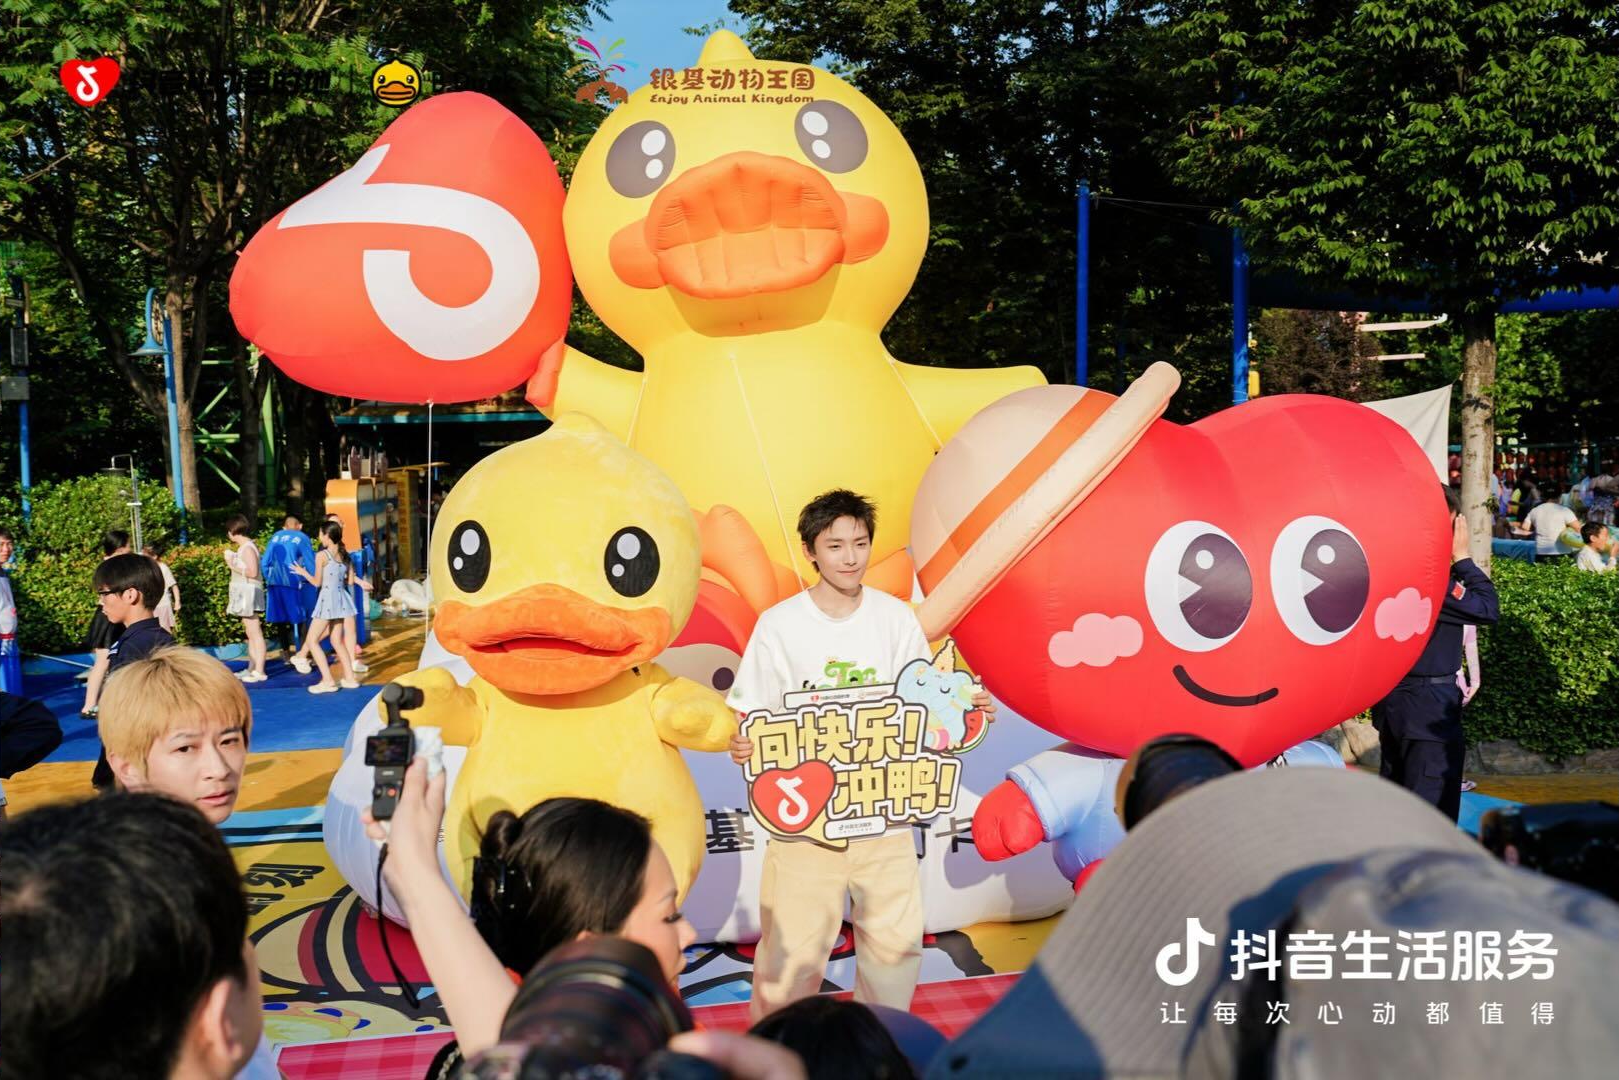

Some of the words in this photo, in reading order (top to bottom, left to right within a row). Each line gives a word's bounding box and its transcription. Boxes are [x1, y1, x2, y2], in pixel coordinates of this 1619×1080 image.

[747, 703, 921, 776] 向快乐!
[833, 758, 958, 818] 冲鸭!
